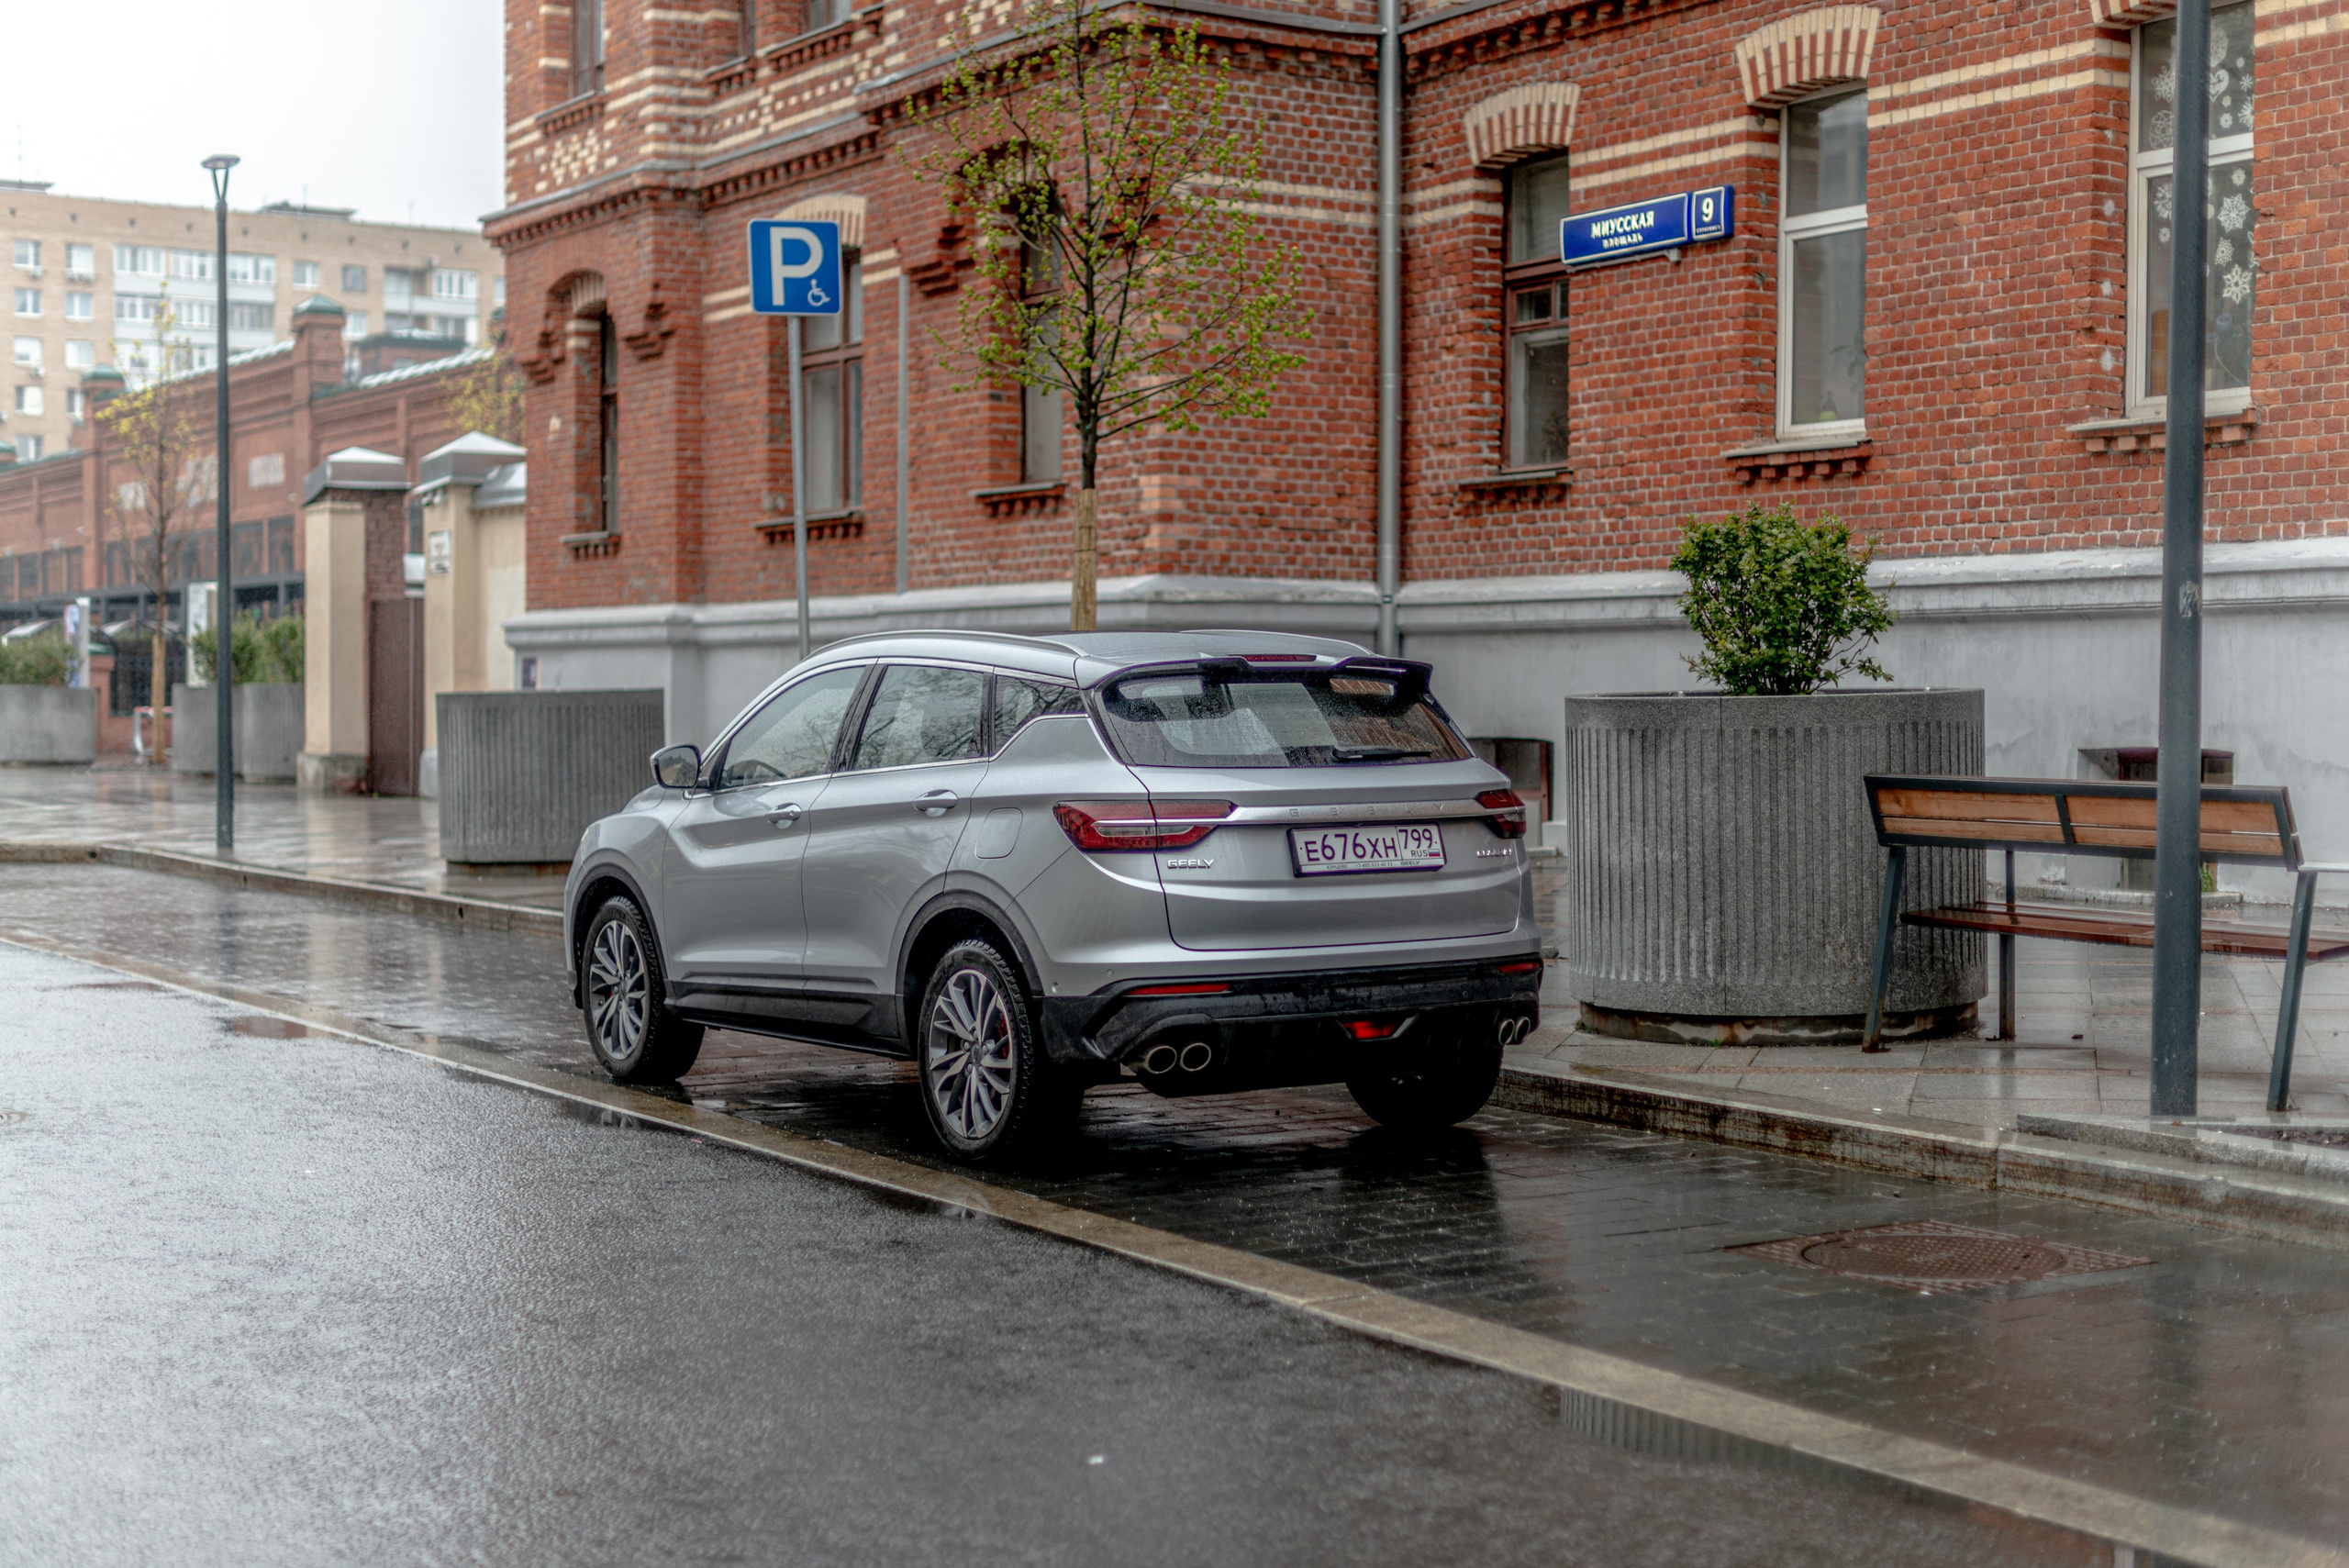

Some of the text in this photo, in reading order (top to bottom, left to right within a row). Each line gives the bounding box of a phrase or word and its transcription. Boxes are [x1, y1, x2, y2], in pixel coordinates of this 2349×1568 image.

[1702, 197, 1714, 222] 9
[1590, 210, 1654, 239] МИУССКАЯ
[1602, 232, 1643, 250] ПЛОЩАДЬ
[770, 227, 823, 306] P
[1167, 859, 1214, 869] GEELY
